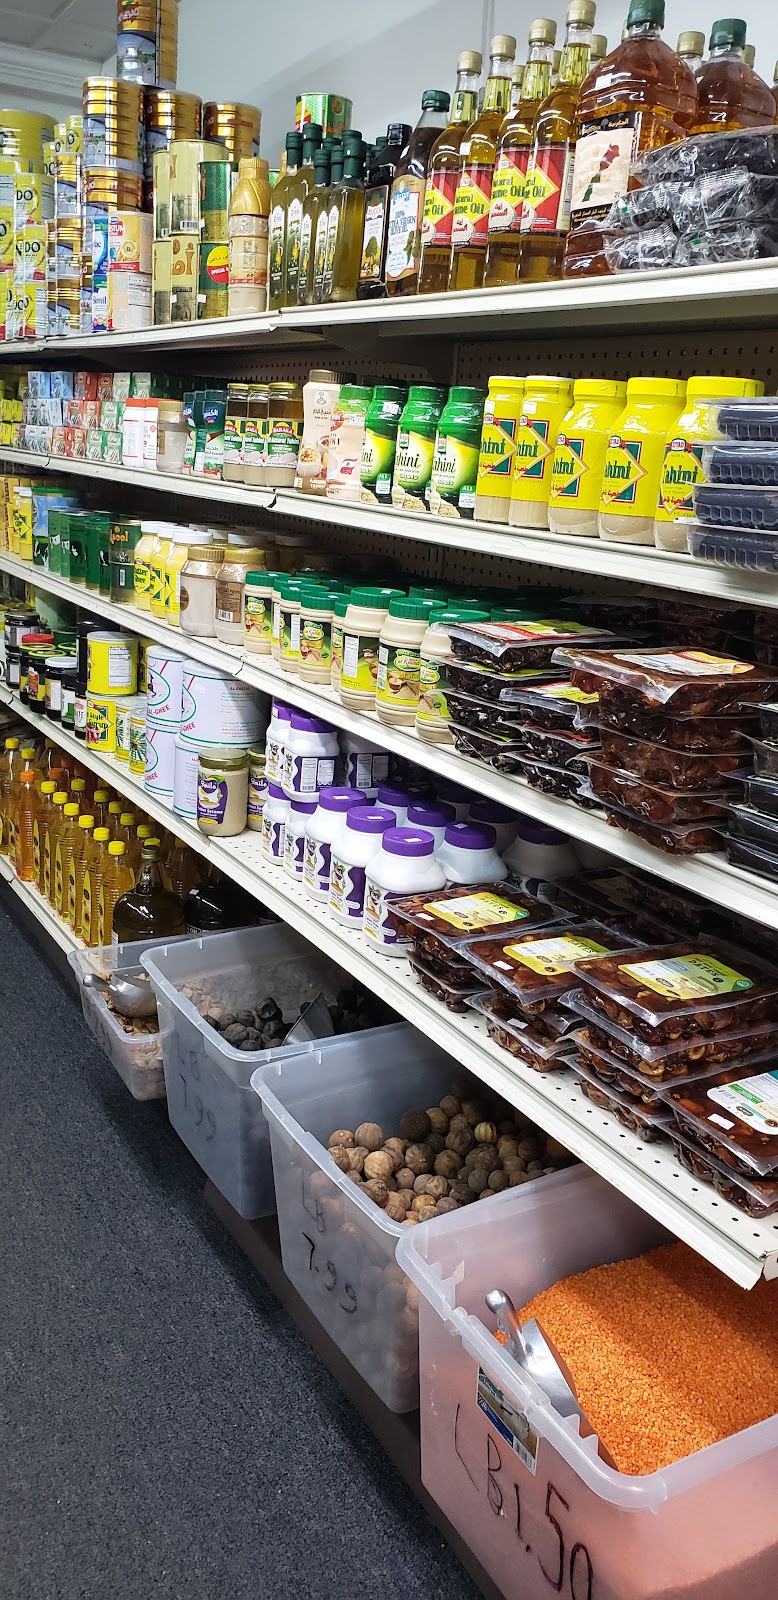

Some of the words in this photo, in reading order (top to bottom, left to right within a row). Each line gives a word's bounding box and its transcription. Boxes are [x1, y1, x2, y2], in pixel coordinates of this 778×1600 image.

[493, 177, 514, 187] atural
[510, 186, 526, 198] Oil
[532, 186, 546, 198] Oil
[431, 204, 444, 215] Oil
[469, 203, 485, 214] Oil
[92, 295, 107, 305] Simil
[481, 437, 506, 456] hini
[517, 437, 538, 458] hini
[396, 451, 421, 468] ahini
[432, 455, 457, 473] ahini
[552, 457, 574, 476] ahini
[604, 461, 632, 480] ahini
[133, 566, 148, 577] utter
[200, 780, 217, 790] Smile
[687, 959, 719, 977] DATES
